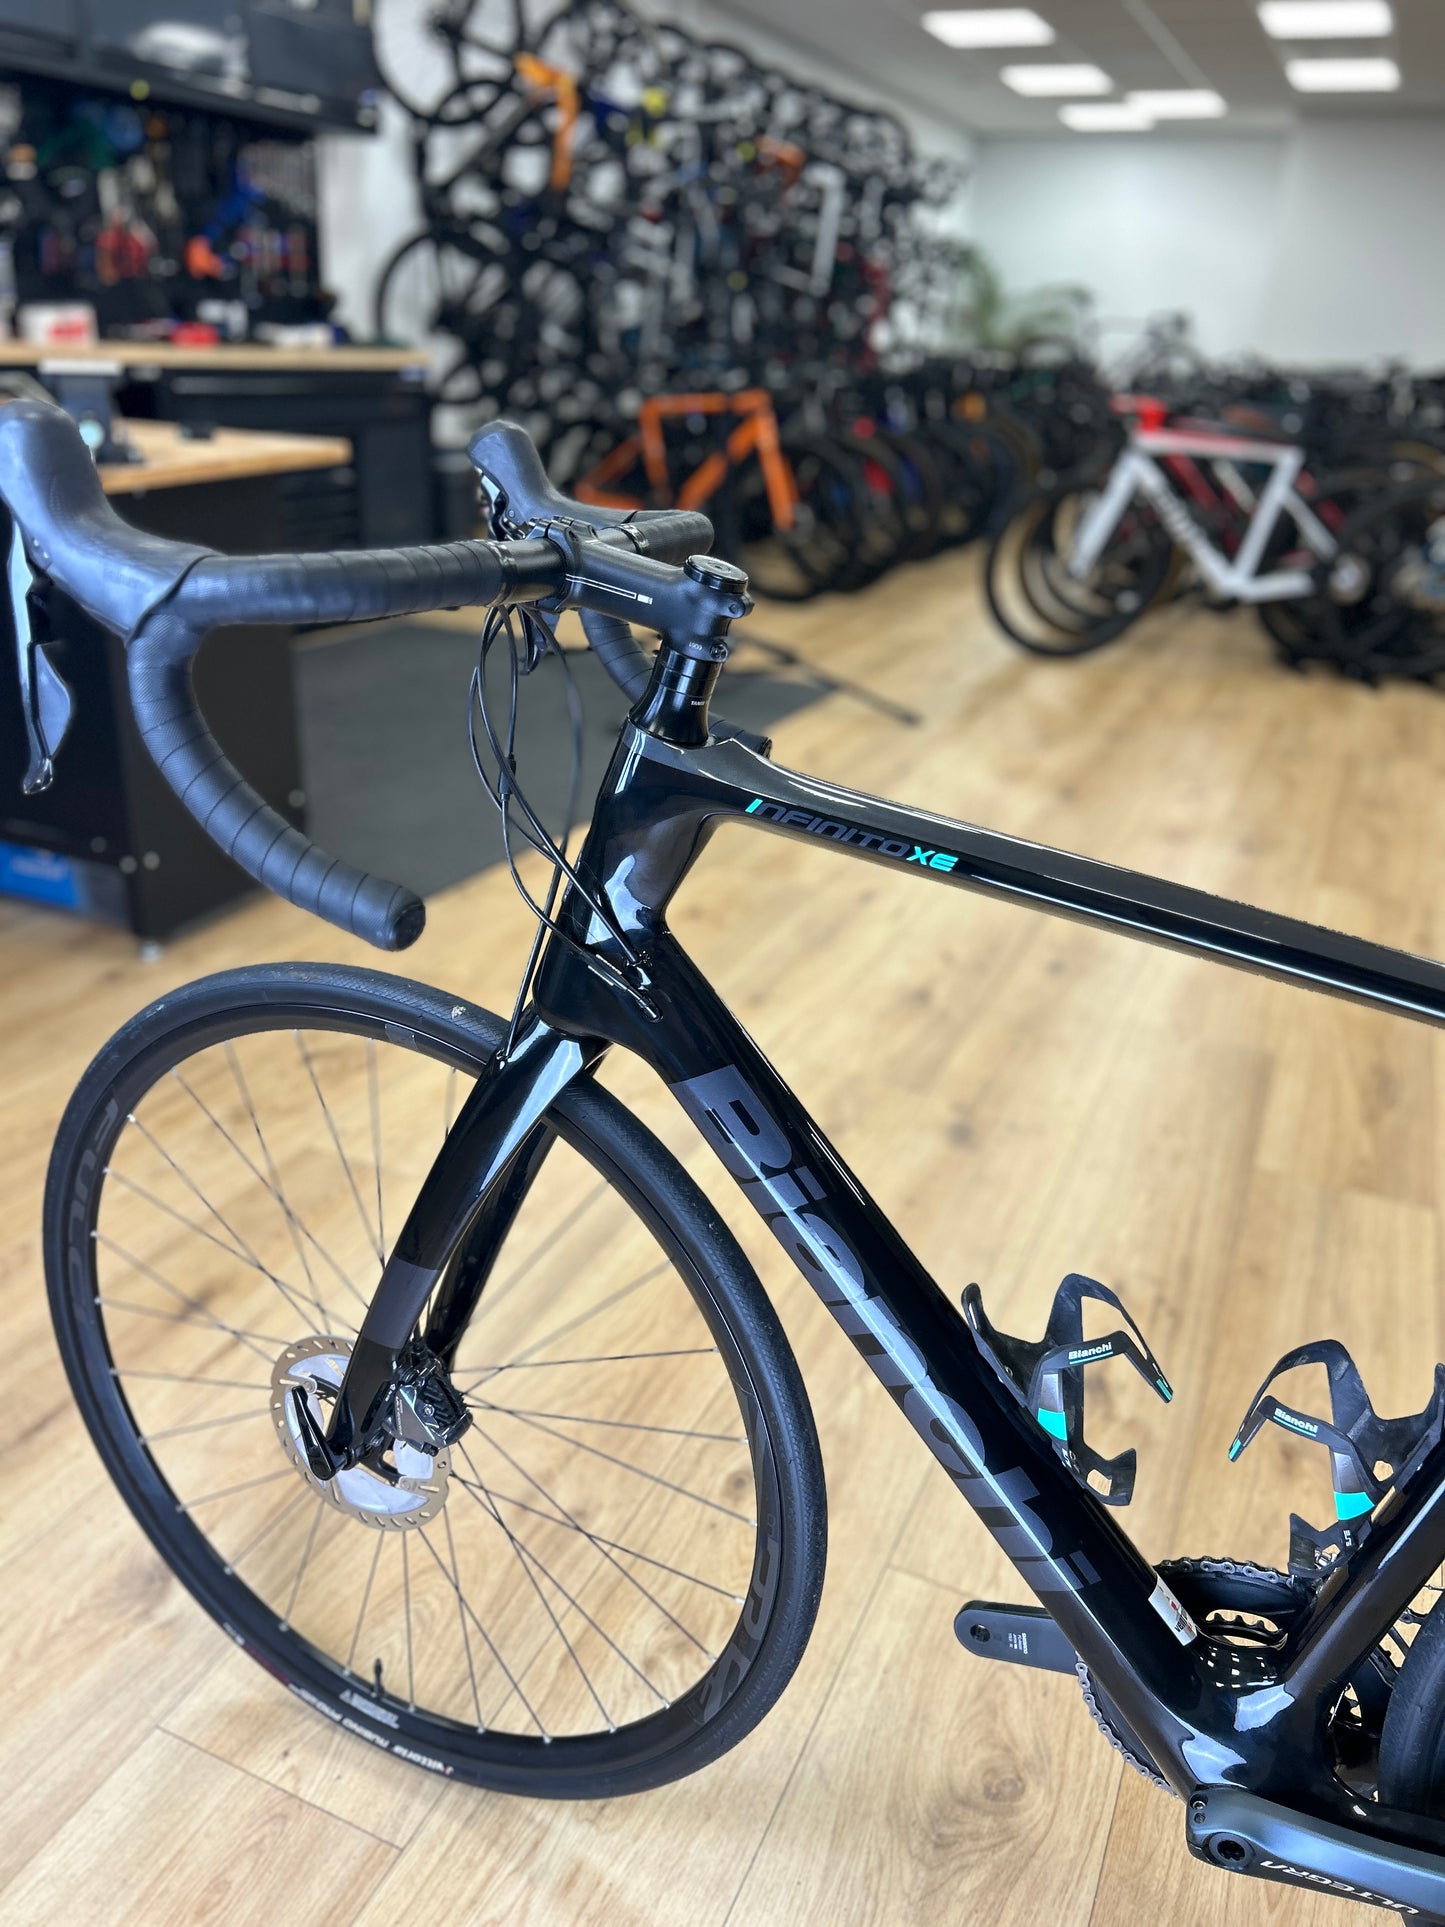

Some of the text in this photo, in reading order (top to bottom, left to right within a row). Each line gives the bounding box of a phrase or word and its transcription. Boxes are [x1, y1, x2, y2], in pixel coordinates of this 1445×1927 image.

[745, 798, 959, 872] INFINITO XE
[667, 1063, 1102, 1594] Bianchi
[1068, 1341, 1112, 1360] Bianchi
[1274, 1407, 1319, 1434] Bianchi
[1259, 1859, 1420, 1915] ULTEGRA
